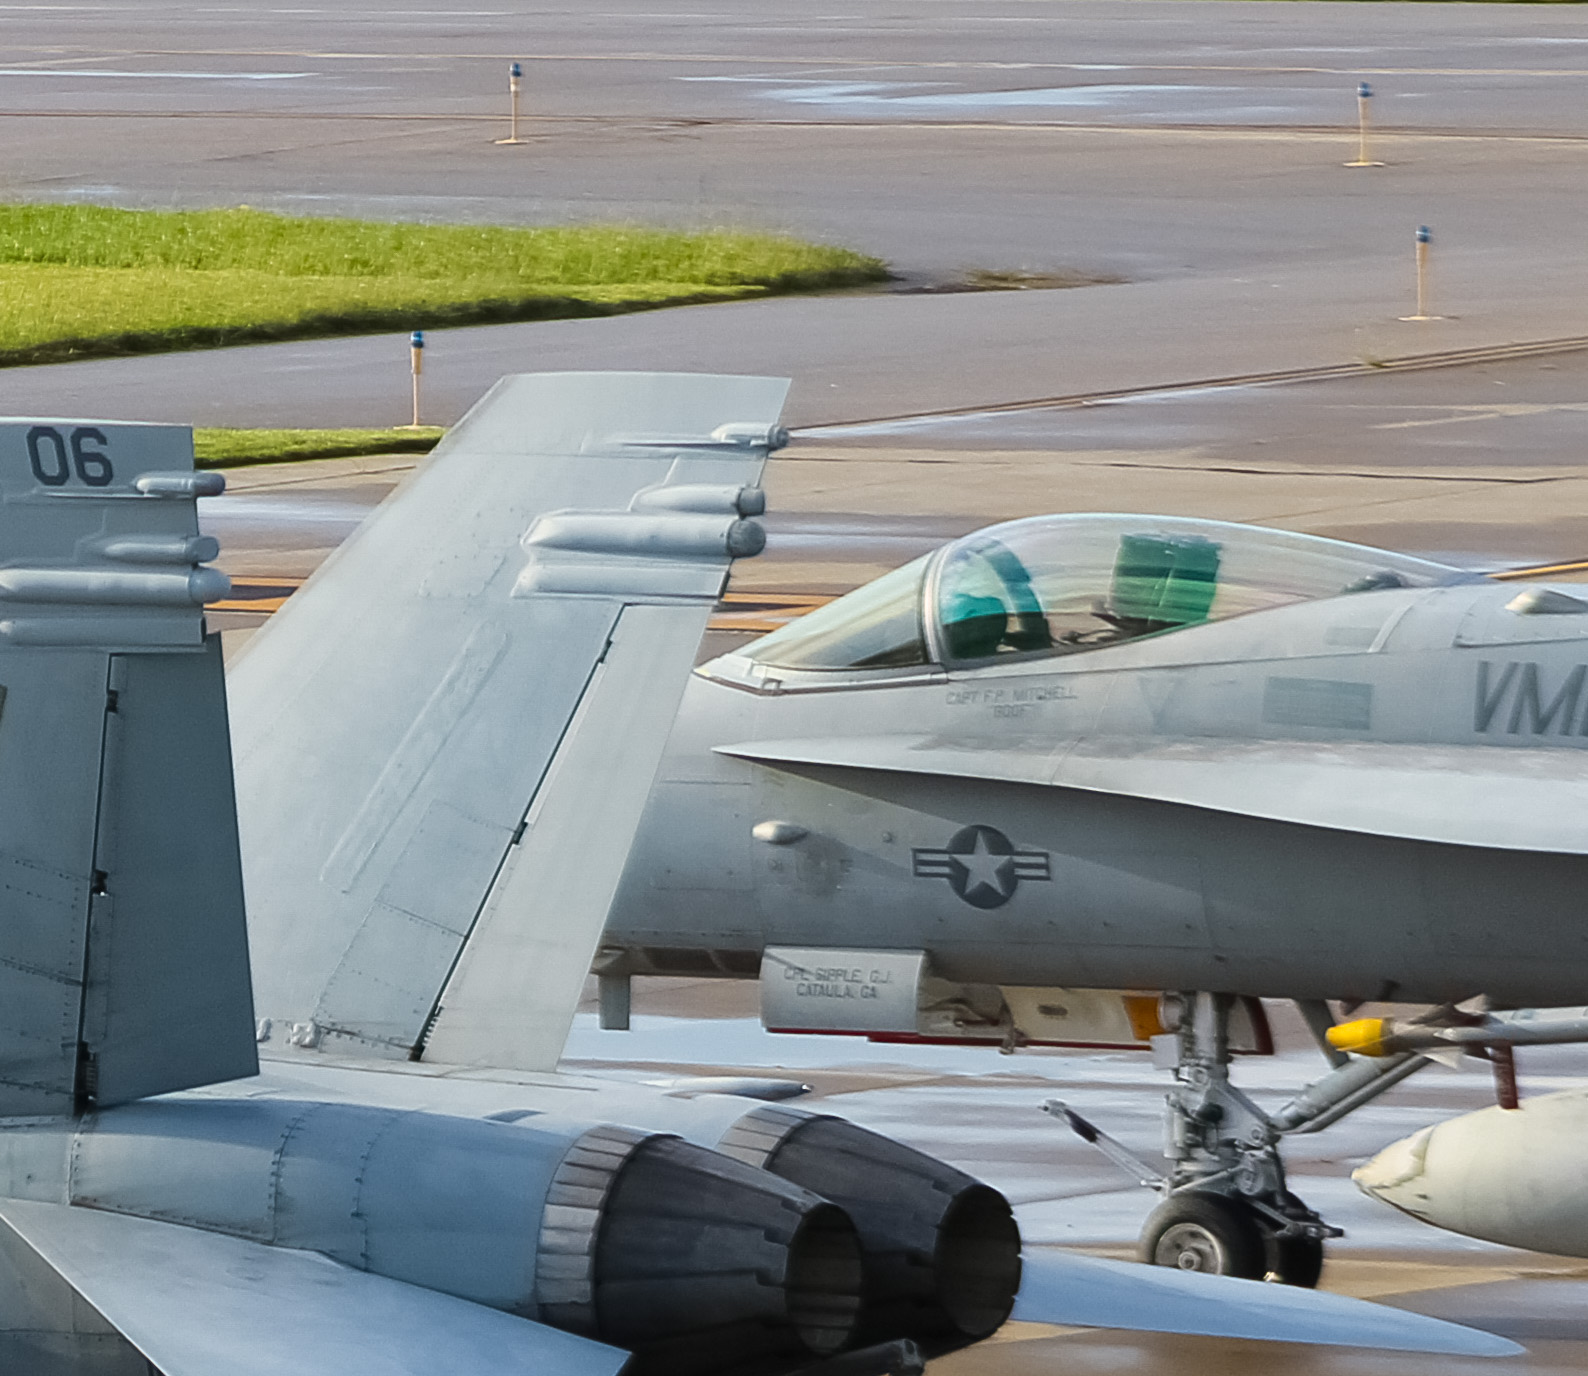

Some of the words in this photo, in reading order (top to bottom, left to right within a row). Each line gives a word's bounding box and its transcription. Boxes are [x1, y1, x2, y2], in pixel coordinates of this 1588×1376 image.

[27, 426, 113, 486] 06
[1474, 660, 1588, 737] VM
[783, 966, 810, 981] CPL
